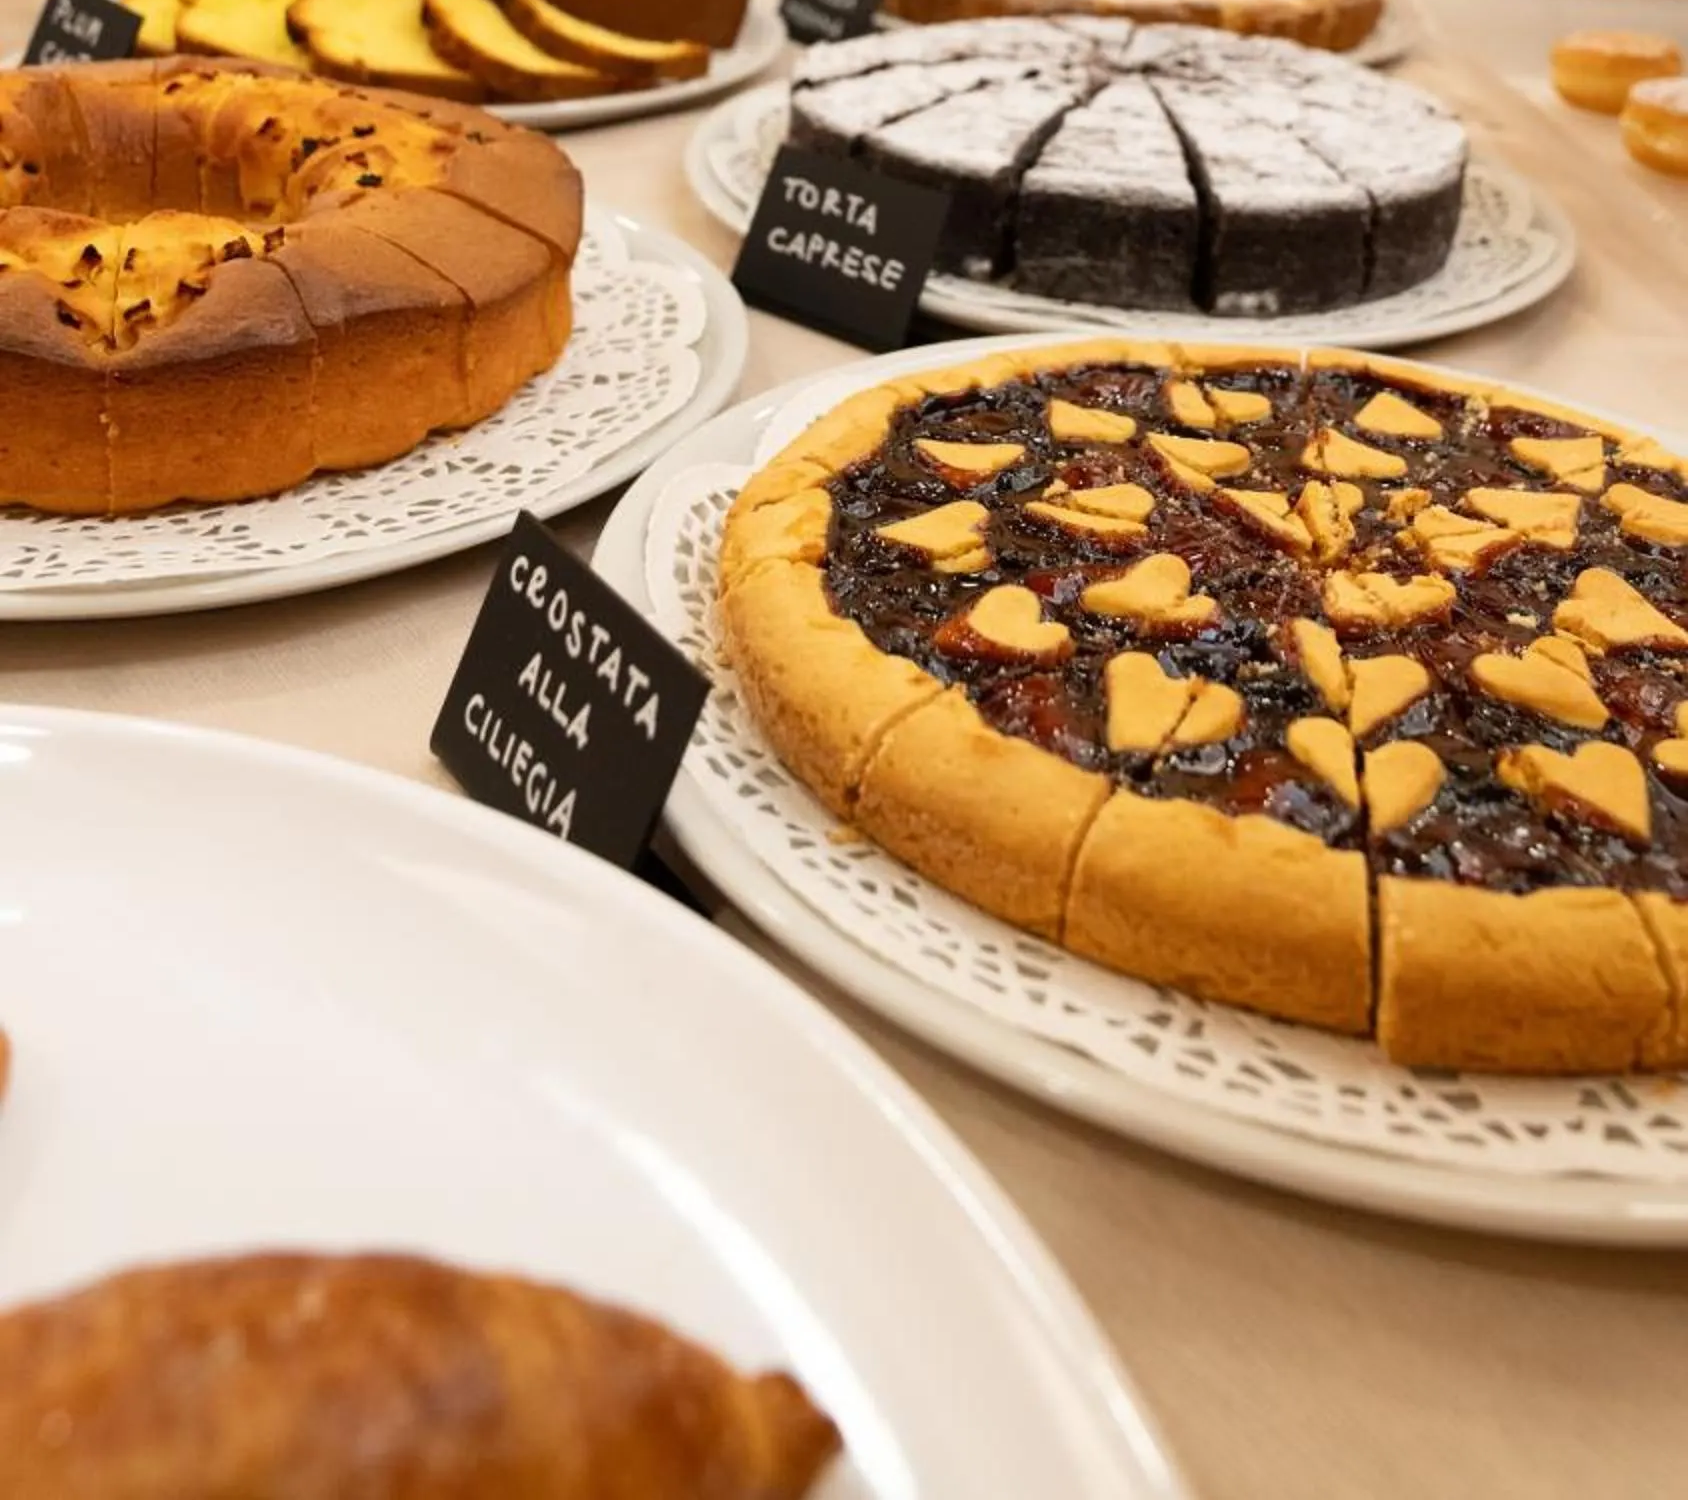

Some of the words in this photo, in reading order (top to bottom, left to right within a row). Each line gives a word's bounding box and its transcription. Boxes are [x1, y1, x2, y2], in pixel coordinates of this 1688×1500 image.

[783, 176, 878, 235] TORTA
[766, 226, 906, 291] CAPRESE
[510, 554, 660, 740] CROSTATA
[518, 653, 592, 750] ALLA
[463, 693, 578, 842] CILIEGIA
